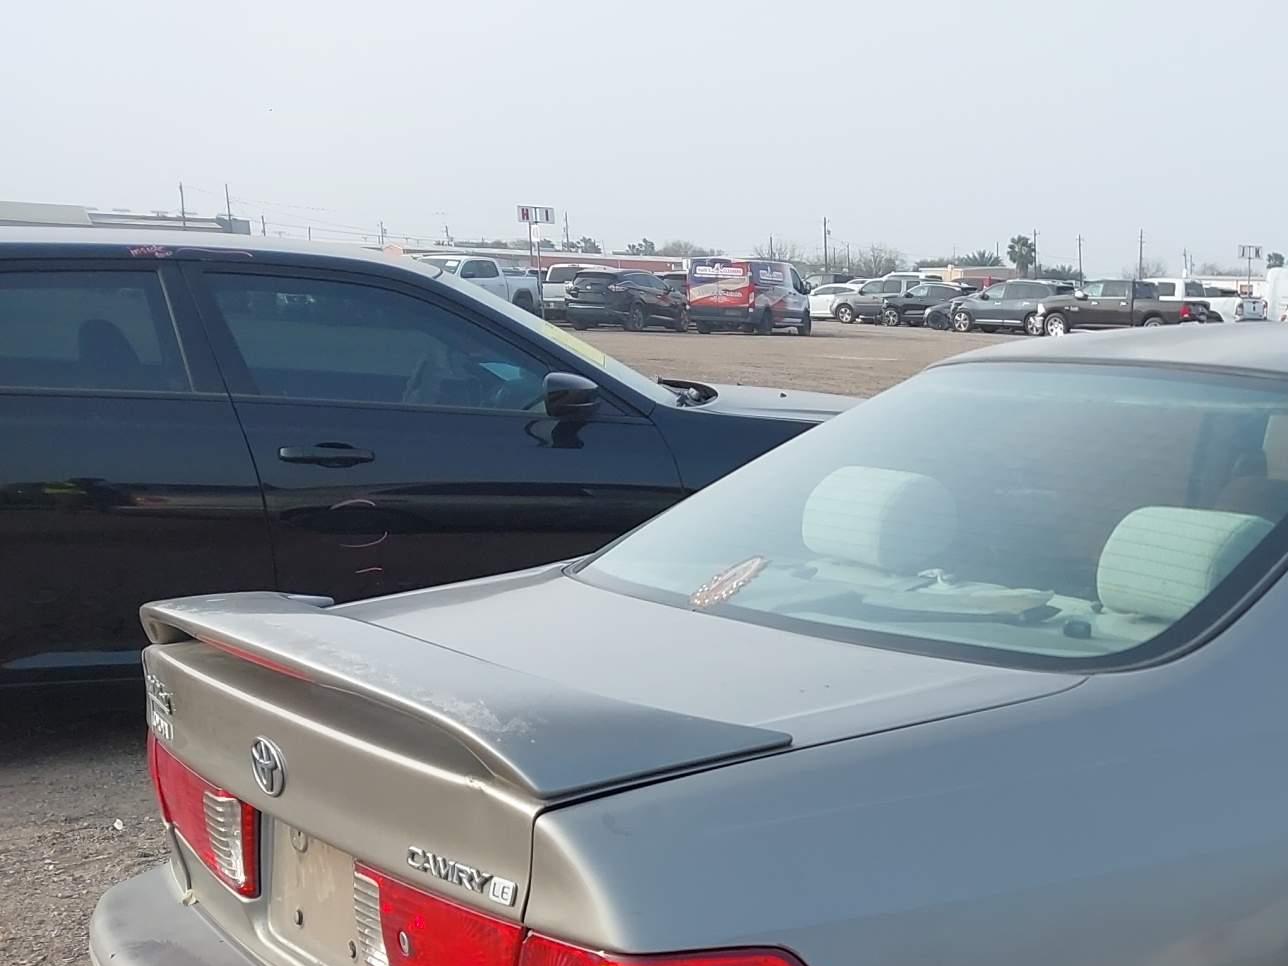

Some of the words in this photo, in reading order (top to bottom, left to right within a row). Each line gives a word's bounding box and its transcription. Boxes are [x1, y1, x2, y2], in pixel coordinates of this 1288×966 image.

[521, 207, 530, 221] H
[407, 846, 494, 894] CAMRY
[491, 881, 512, 902] LE
